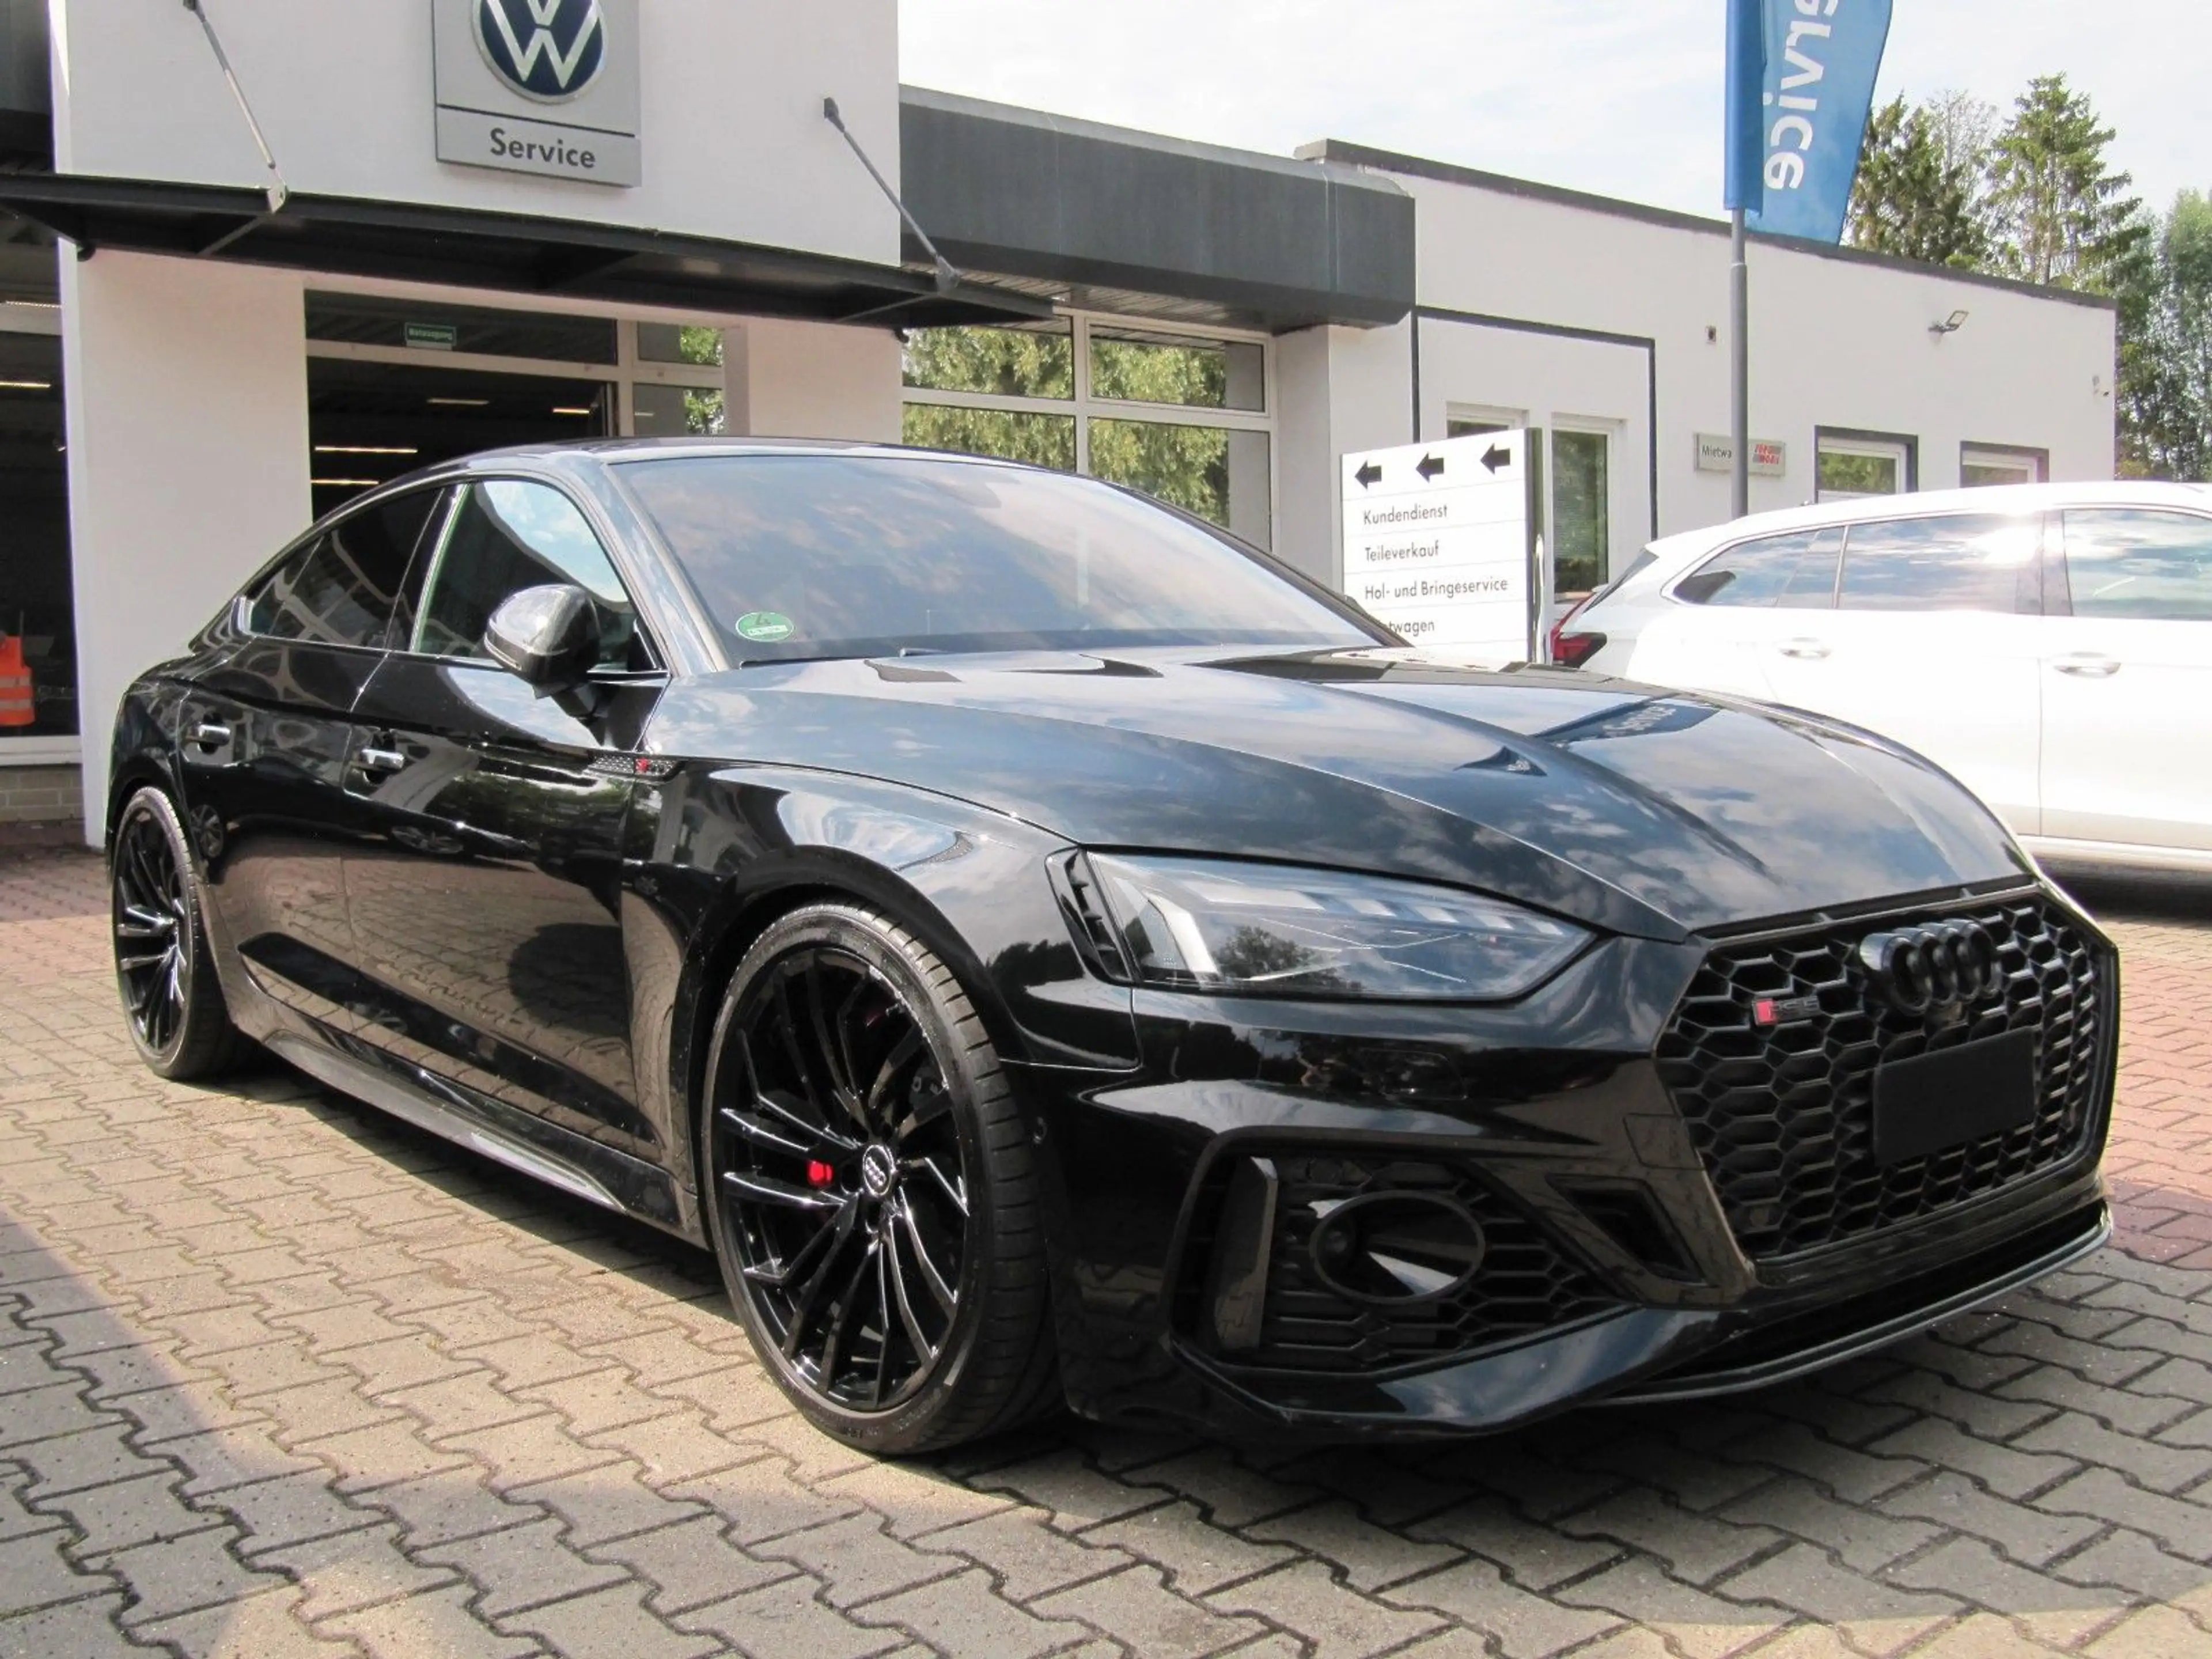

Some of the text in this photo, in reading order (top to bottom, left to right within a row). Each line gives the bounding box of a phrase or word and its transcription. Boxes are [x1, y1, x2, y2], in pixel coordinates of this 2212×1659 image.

[490, 127, 596, 169] Service
[1701, 444, 1732, 459] Mietwa
[1363, 503, 1448, 525] Kundendienst
[1365, 539, 1440, 562] Teileverkauf
[1364, 576, 1508, 600] Hol- und Bringeservice
[1388, 620, 1435, 637] twagen
